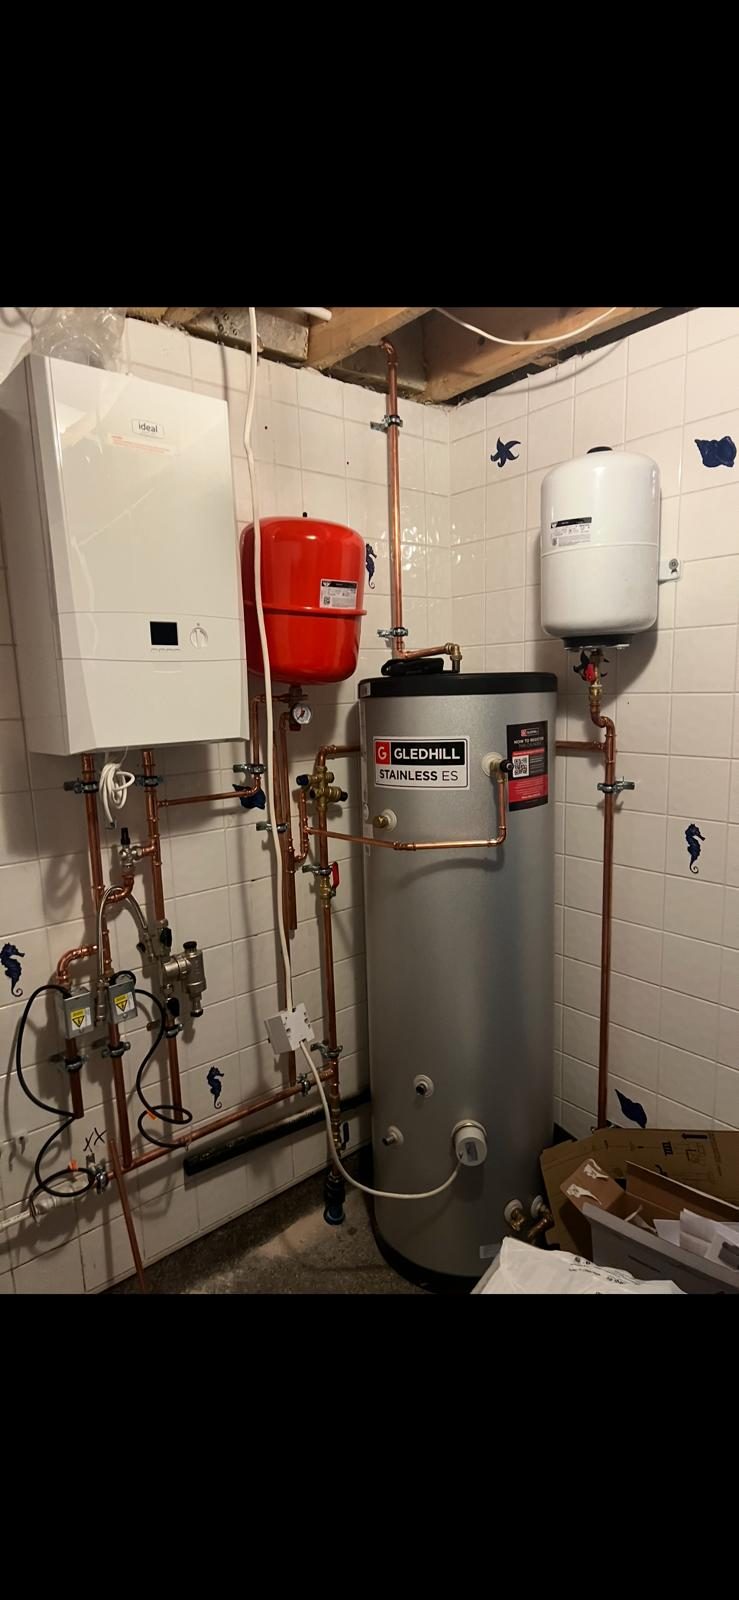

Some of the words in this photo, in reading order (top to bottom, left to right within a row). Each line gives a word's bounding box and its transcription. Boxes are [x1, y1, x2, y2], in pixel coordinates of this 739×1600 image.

[138, 422, 158, 432] ideal
[377, 746, 387, 760] G
[393, 747, 461, 760] GLEDHILL
[379, 769, 438, 781] STAINLESS
[441, 770, 459, 782] ES
